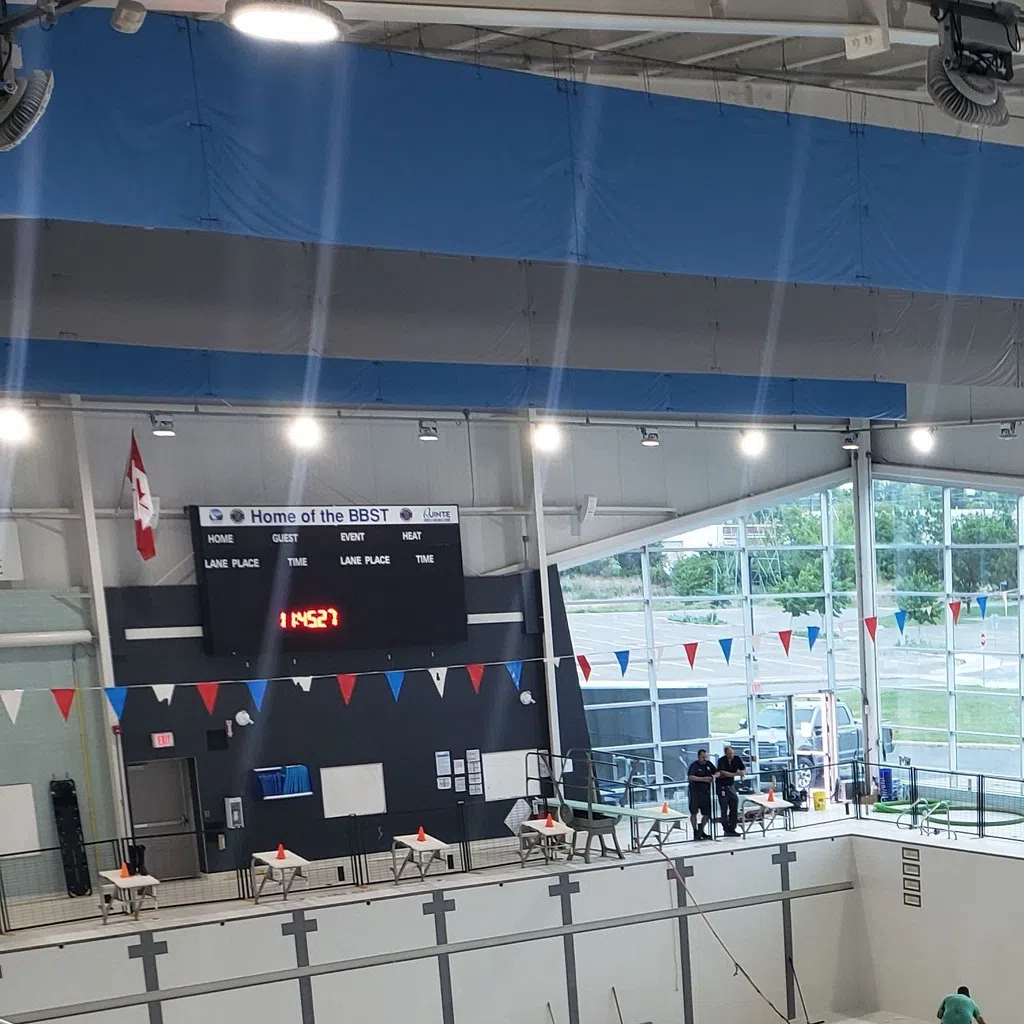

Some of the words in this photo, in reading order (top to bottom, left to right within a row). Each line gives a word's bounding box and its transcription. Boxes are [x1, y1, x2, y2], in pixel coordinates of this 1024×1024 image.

[250, 509, 297, 523] Home
[301, 509, 316, 523] of
[319, 508, 344, 523] the
[348, 508, 389, 522] BBST
[207, 534, 234, 543] HOME
[272, 533, 299, 543] GUEST
[340, 532, 365, 541] EVENT
[402, 531, 422, 540] HEAT
[204, 558, 229, 569] LANE
[231, 558, 260, 568] PLACE
[287, 557, 308, 567] TIME
[340, 556, 362, 565] LANE
[364, 555, 391, 565] PLACE
[415, 554, 435, 564] TIME
